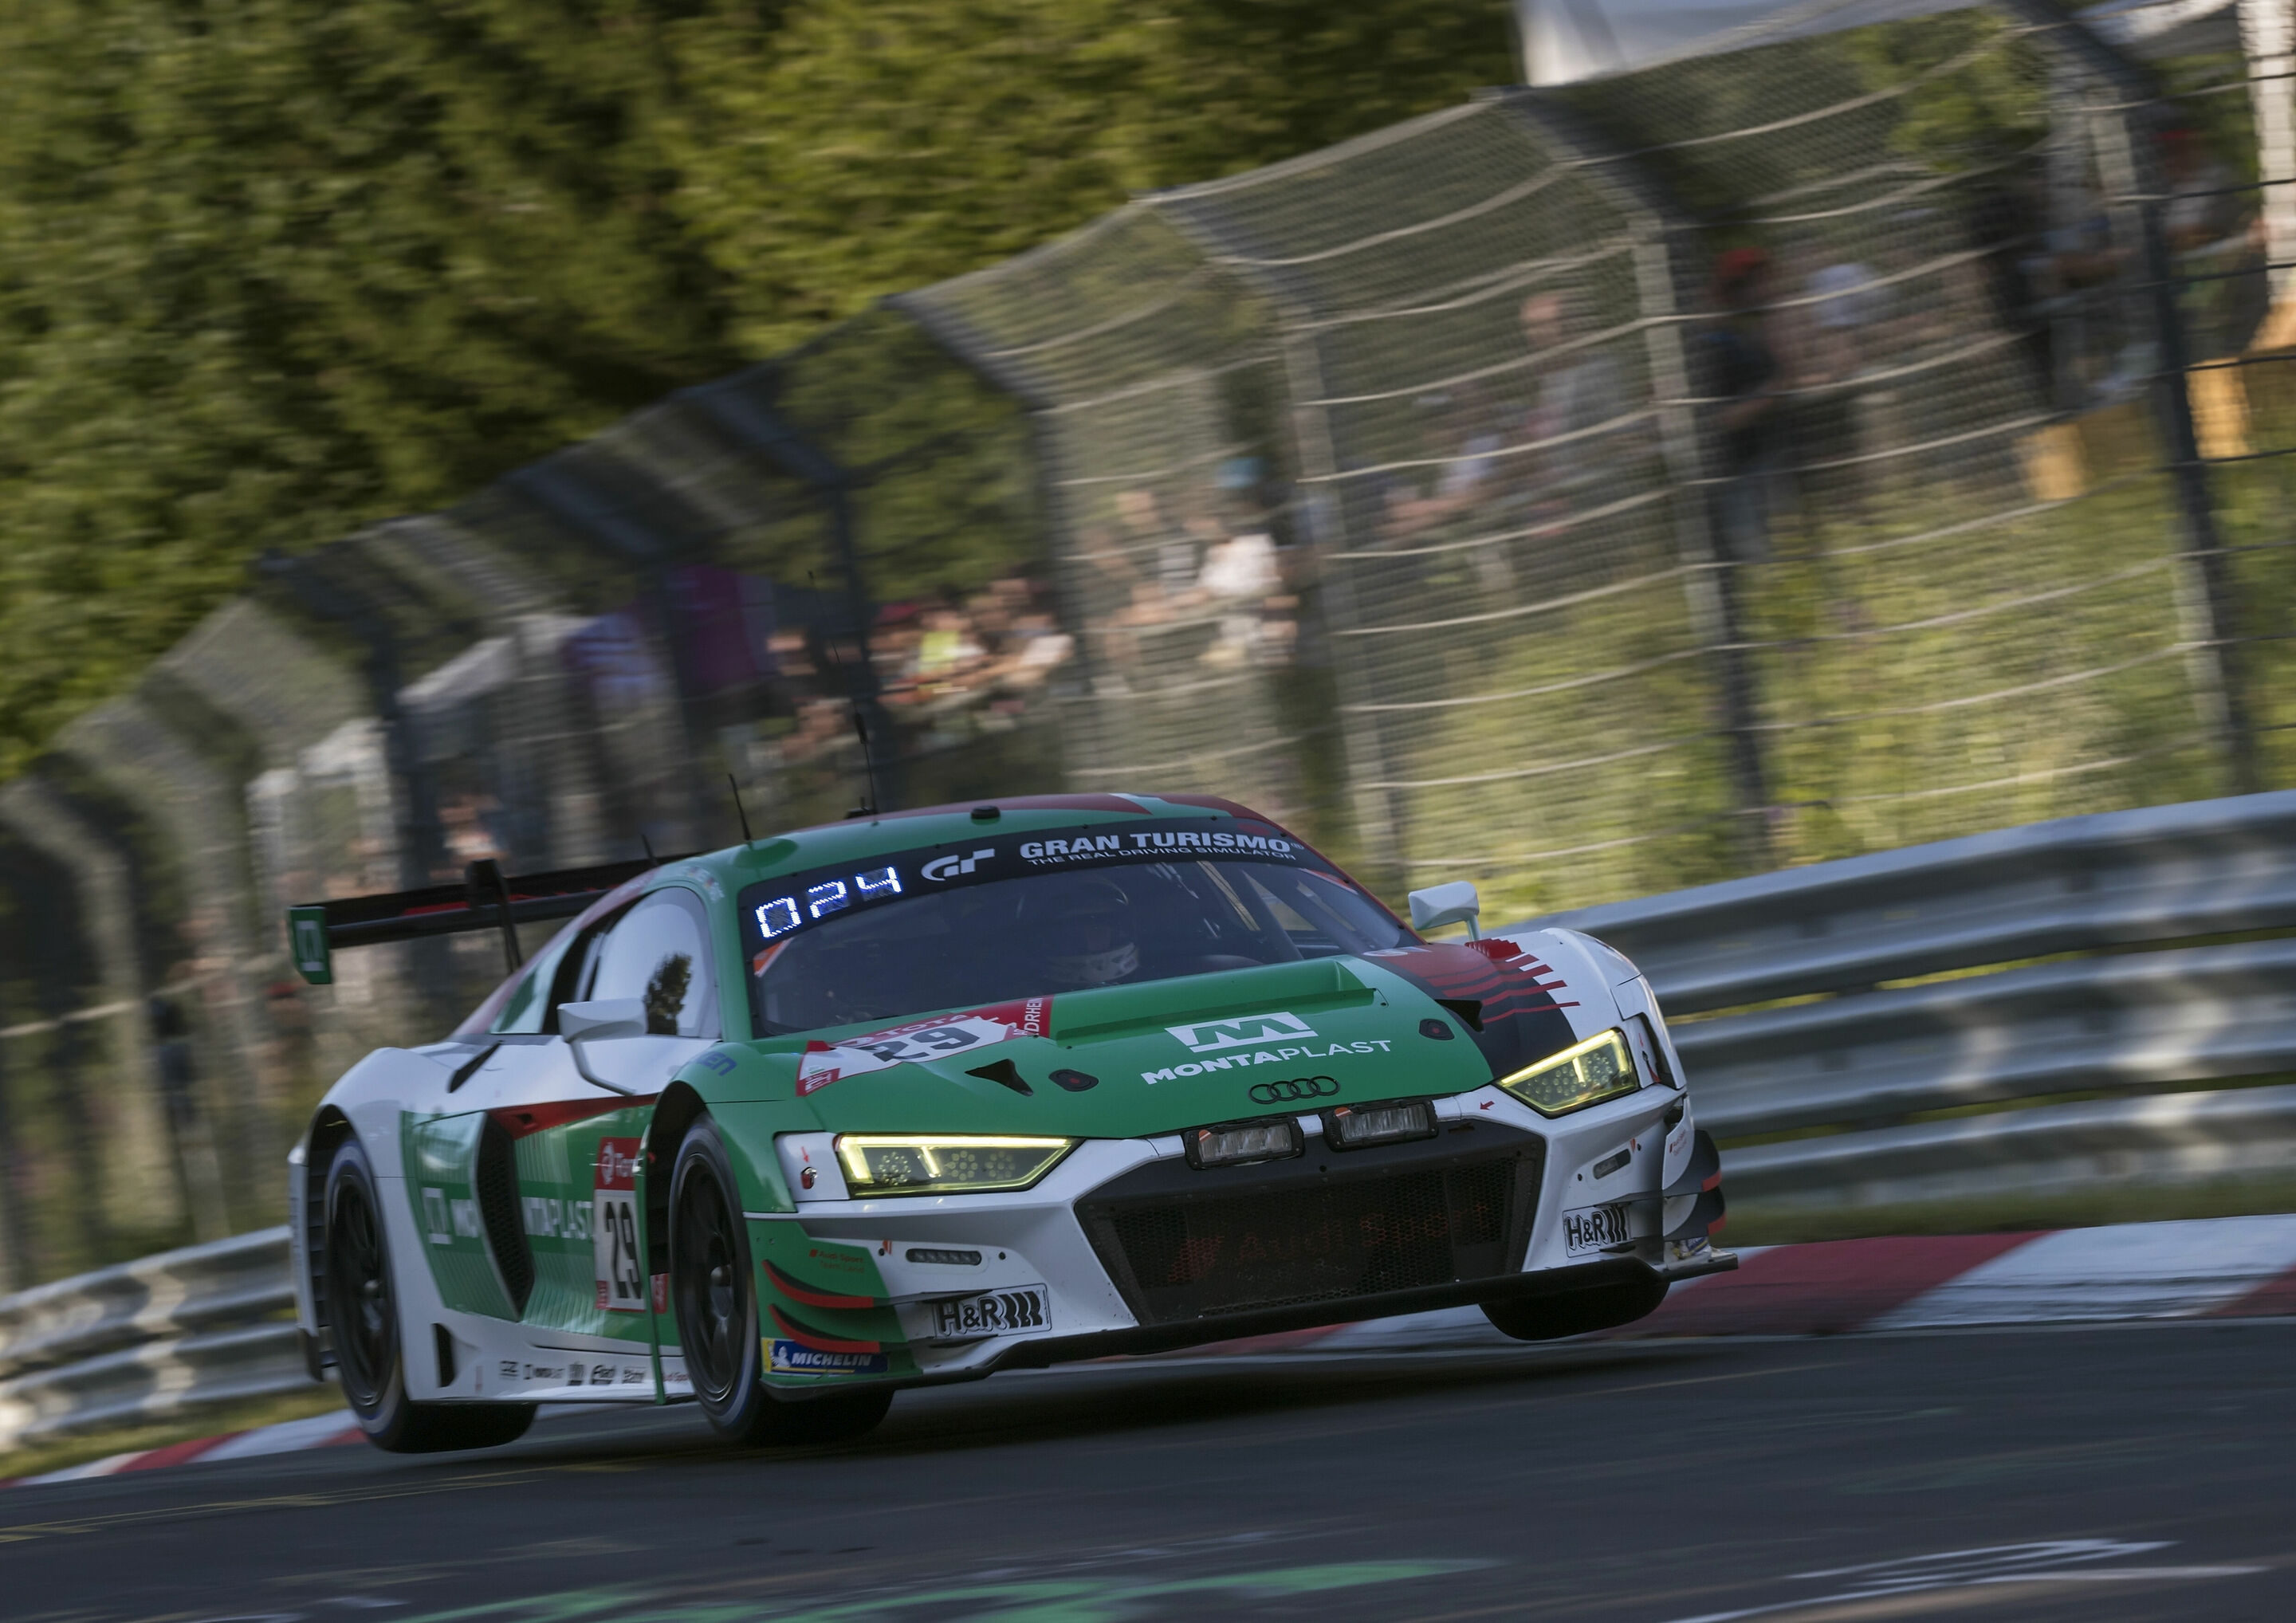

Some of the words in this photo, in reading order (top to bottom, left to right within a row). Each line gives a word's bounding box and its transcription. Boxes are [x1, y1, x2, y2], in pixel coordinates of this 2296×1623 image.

[1020, 835, 1120, 859] GRAN
[1130, 831, 1292, 854] TURISMO
[1028, 855, 1066, 866] THE
[1069, 851, 1110, 862] REAL
[1120, 847, 1193, 856] DRIVING
[1197, 847, 1296, 861] SIMULATOR
[755, 866, 903, 939] 024
[858, 1027, 981, 1063] 29
[1140, 1039, 1392, 1085] MONTAPLAST
[1565, 1211, 1608, 1250] H&R
[605, 1201, 643, 1299] 29
[938, 1298, 1005, 1334] H&R
[790, 1352, 872, 1367] MICHELIN
